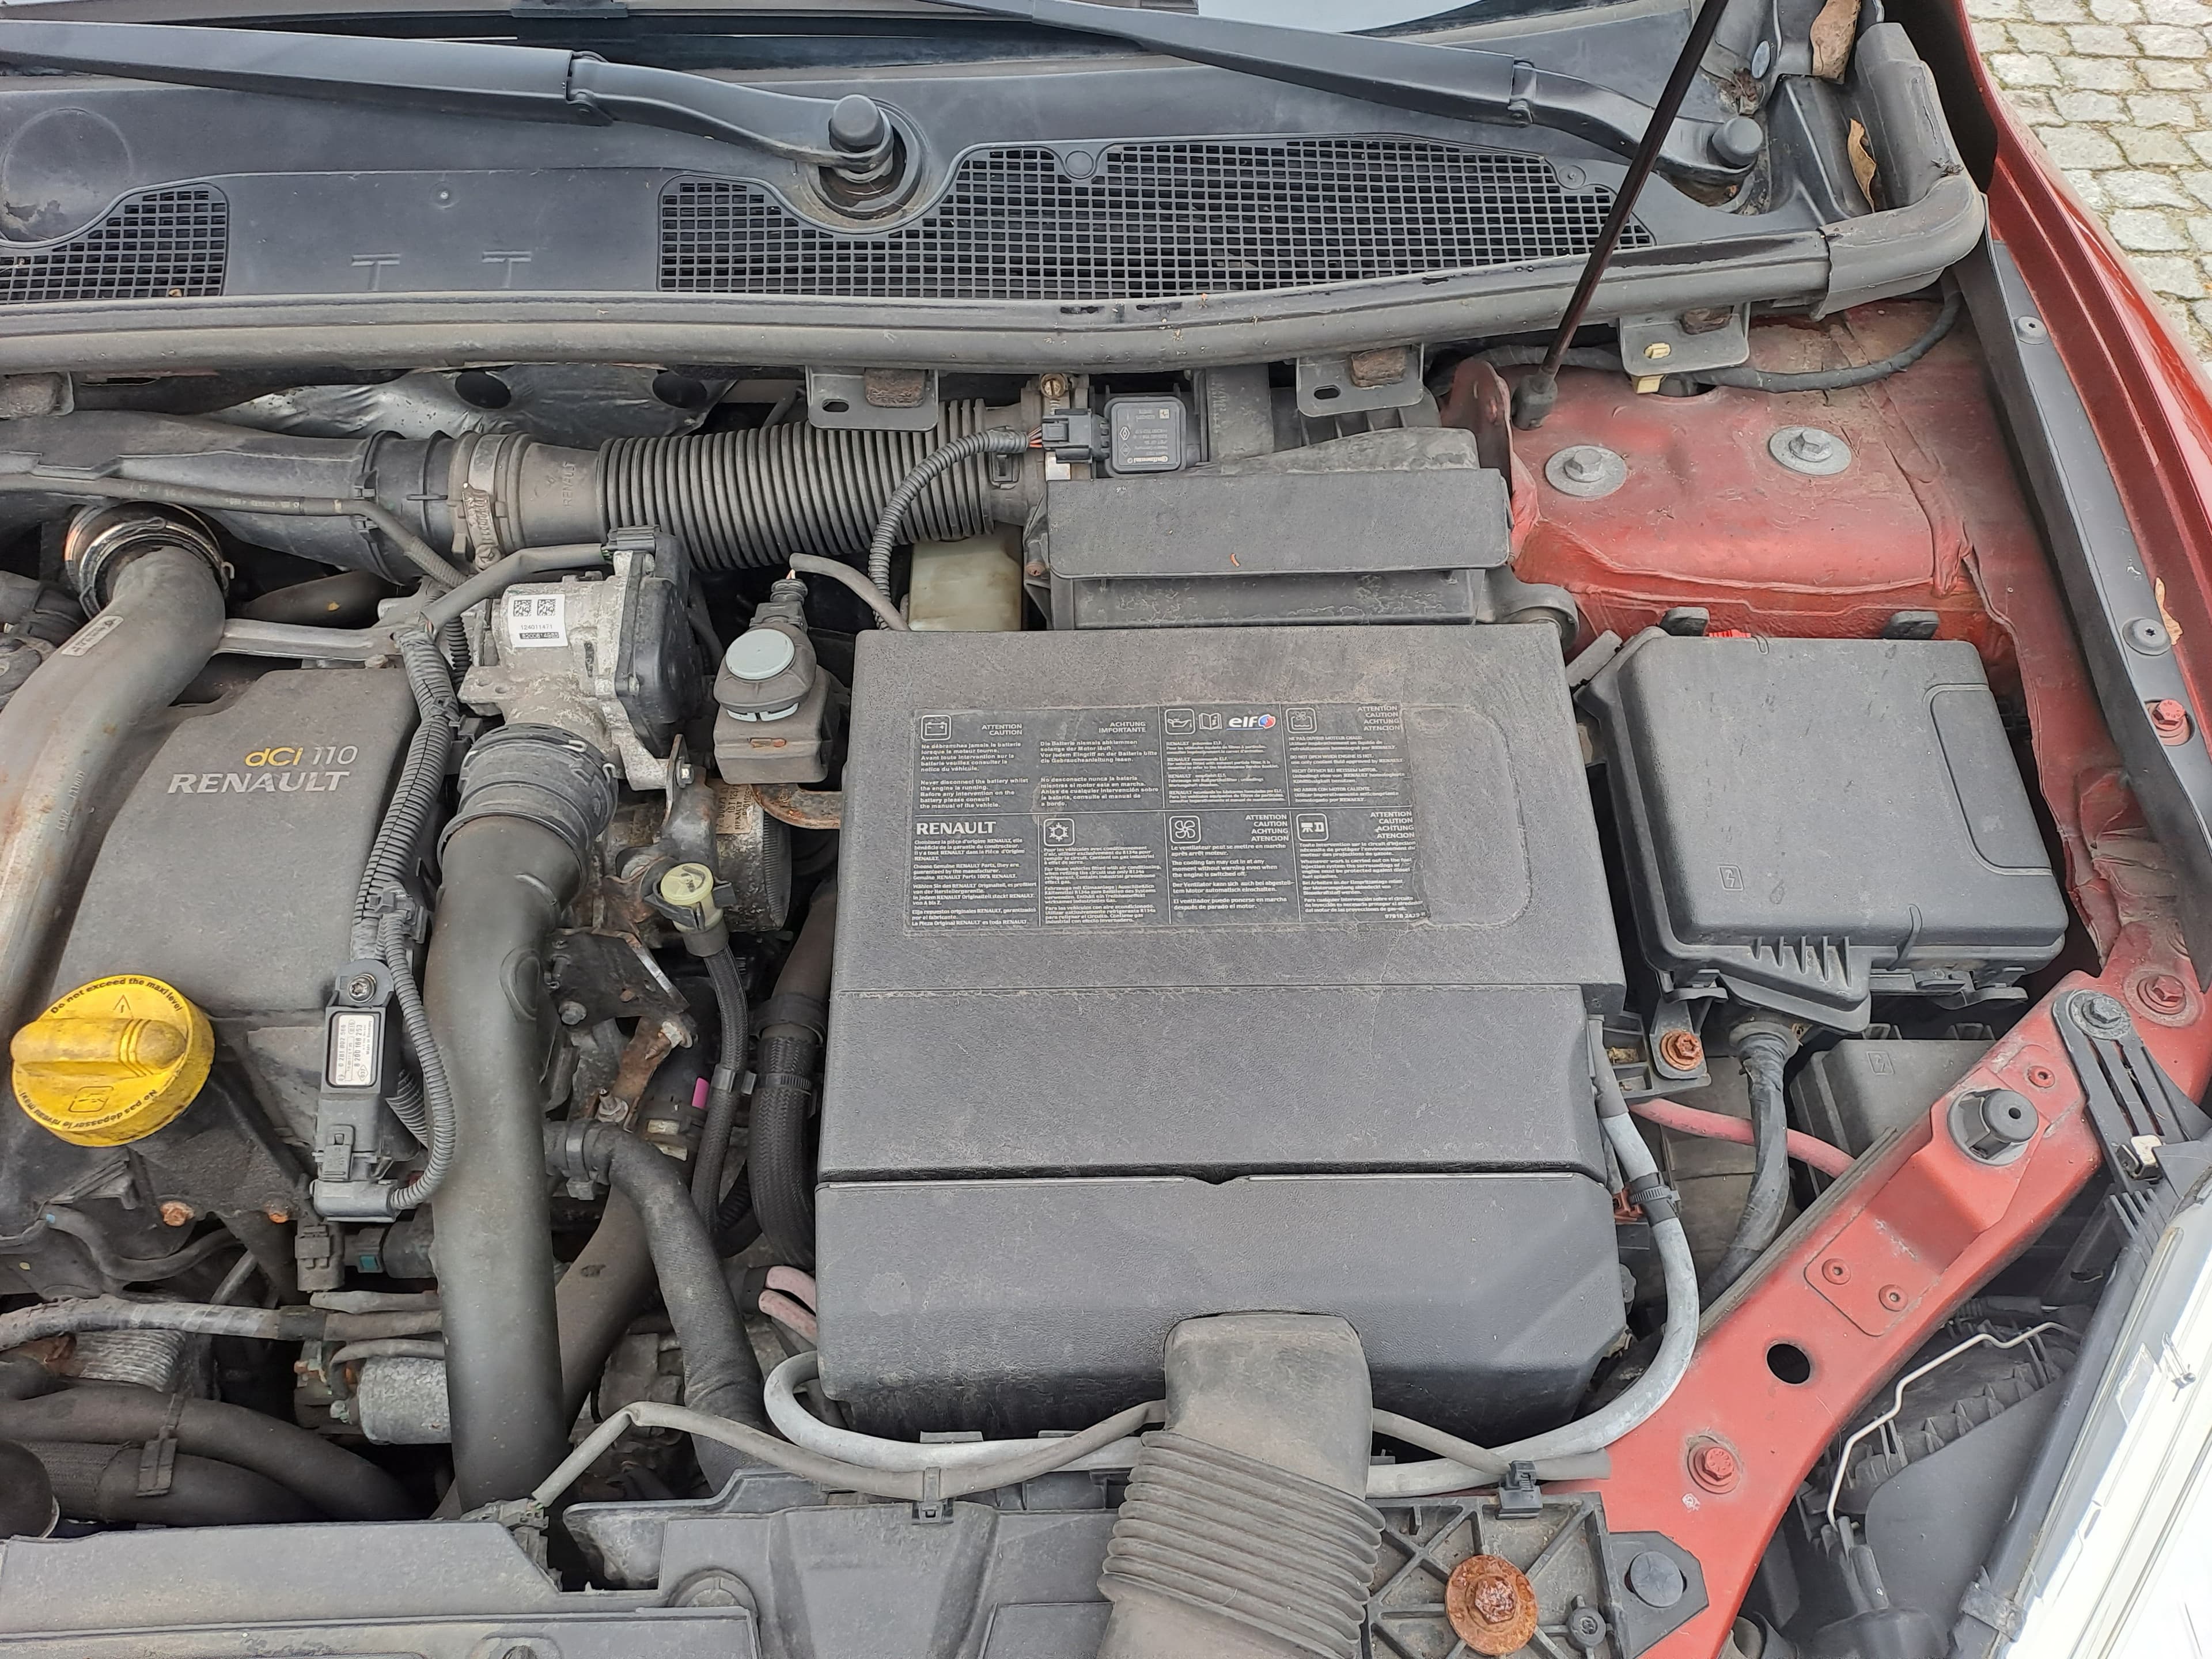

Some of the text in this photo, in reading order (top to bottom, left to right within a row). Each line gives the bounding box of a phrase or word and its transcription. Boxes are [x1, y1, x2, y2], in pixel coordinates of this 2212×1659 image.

[562, 461, 575, 507] RENAULT
[1228, 716, 1258, 727] elf
[245, 745, 358, 767] dCi 110
[167, 771, 350, 794] RENAULT
[916, 821, 996, 835] RENAULT
[51, 1003, 65, 1014] Do
[67, 990, 84, 1002] not
[86, 978, 126, 993] exceed
[166, 991, 183, 1011] level
[124, 1101, 142, 1113] pas
